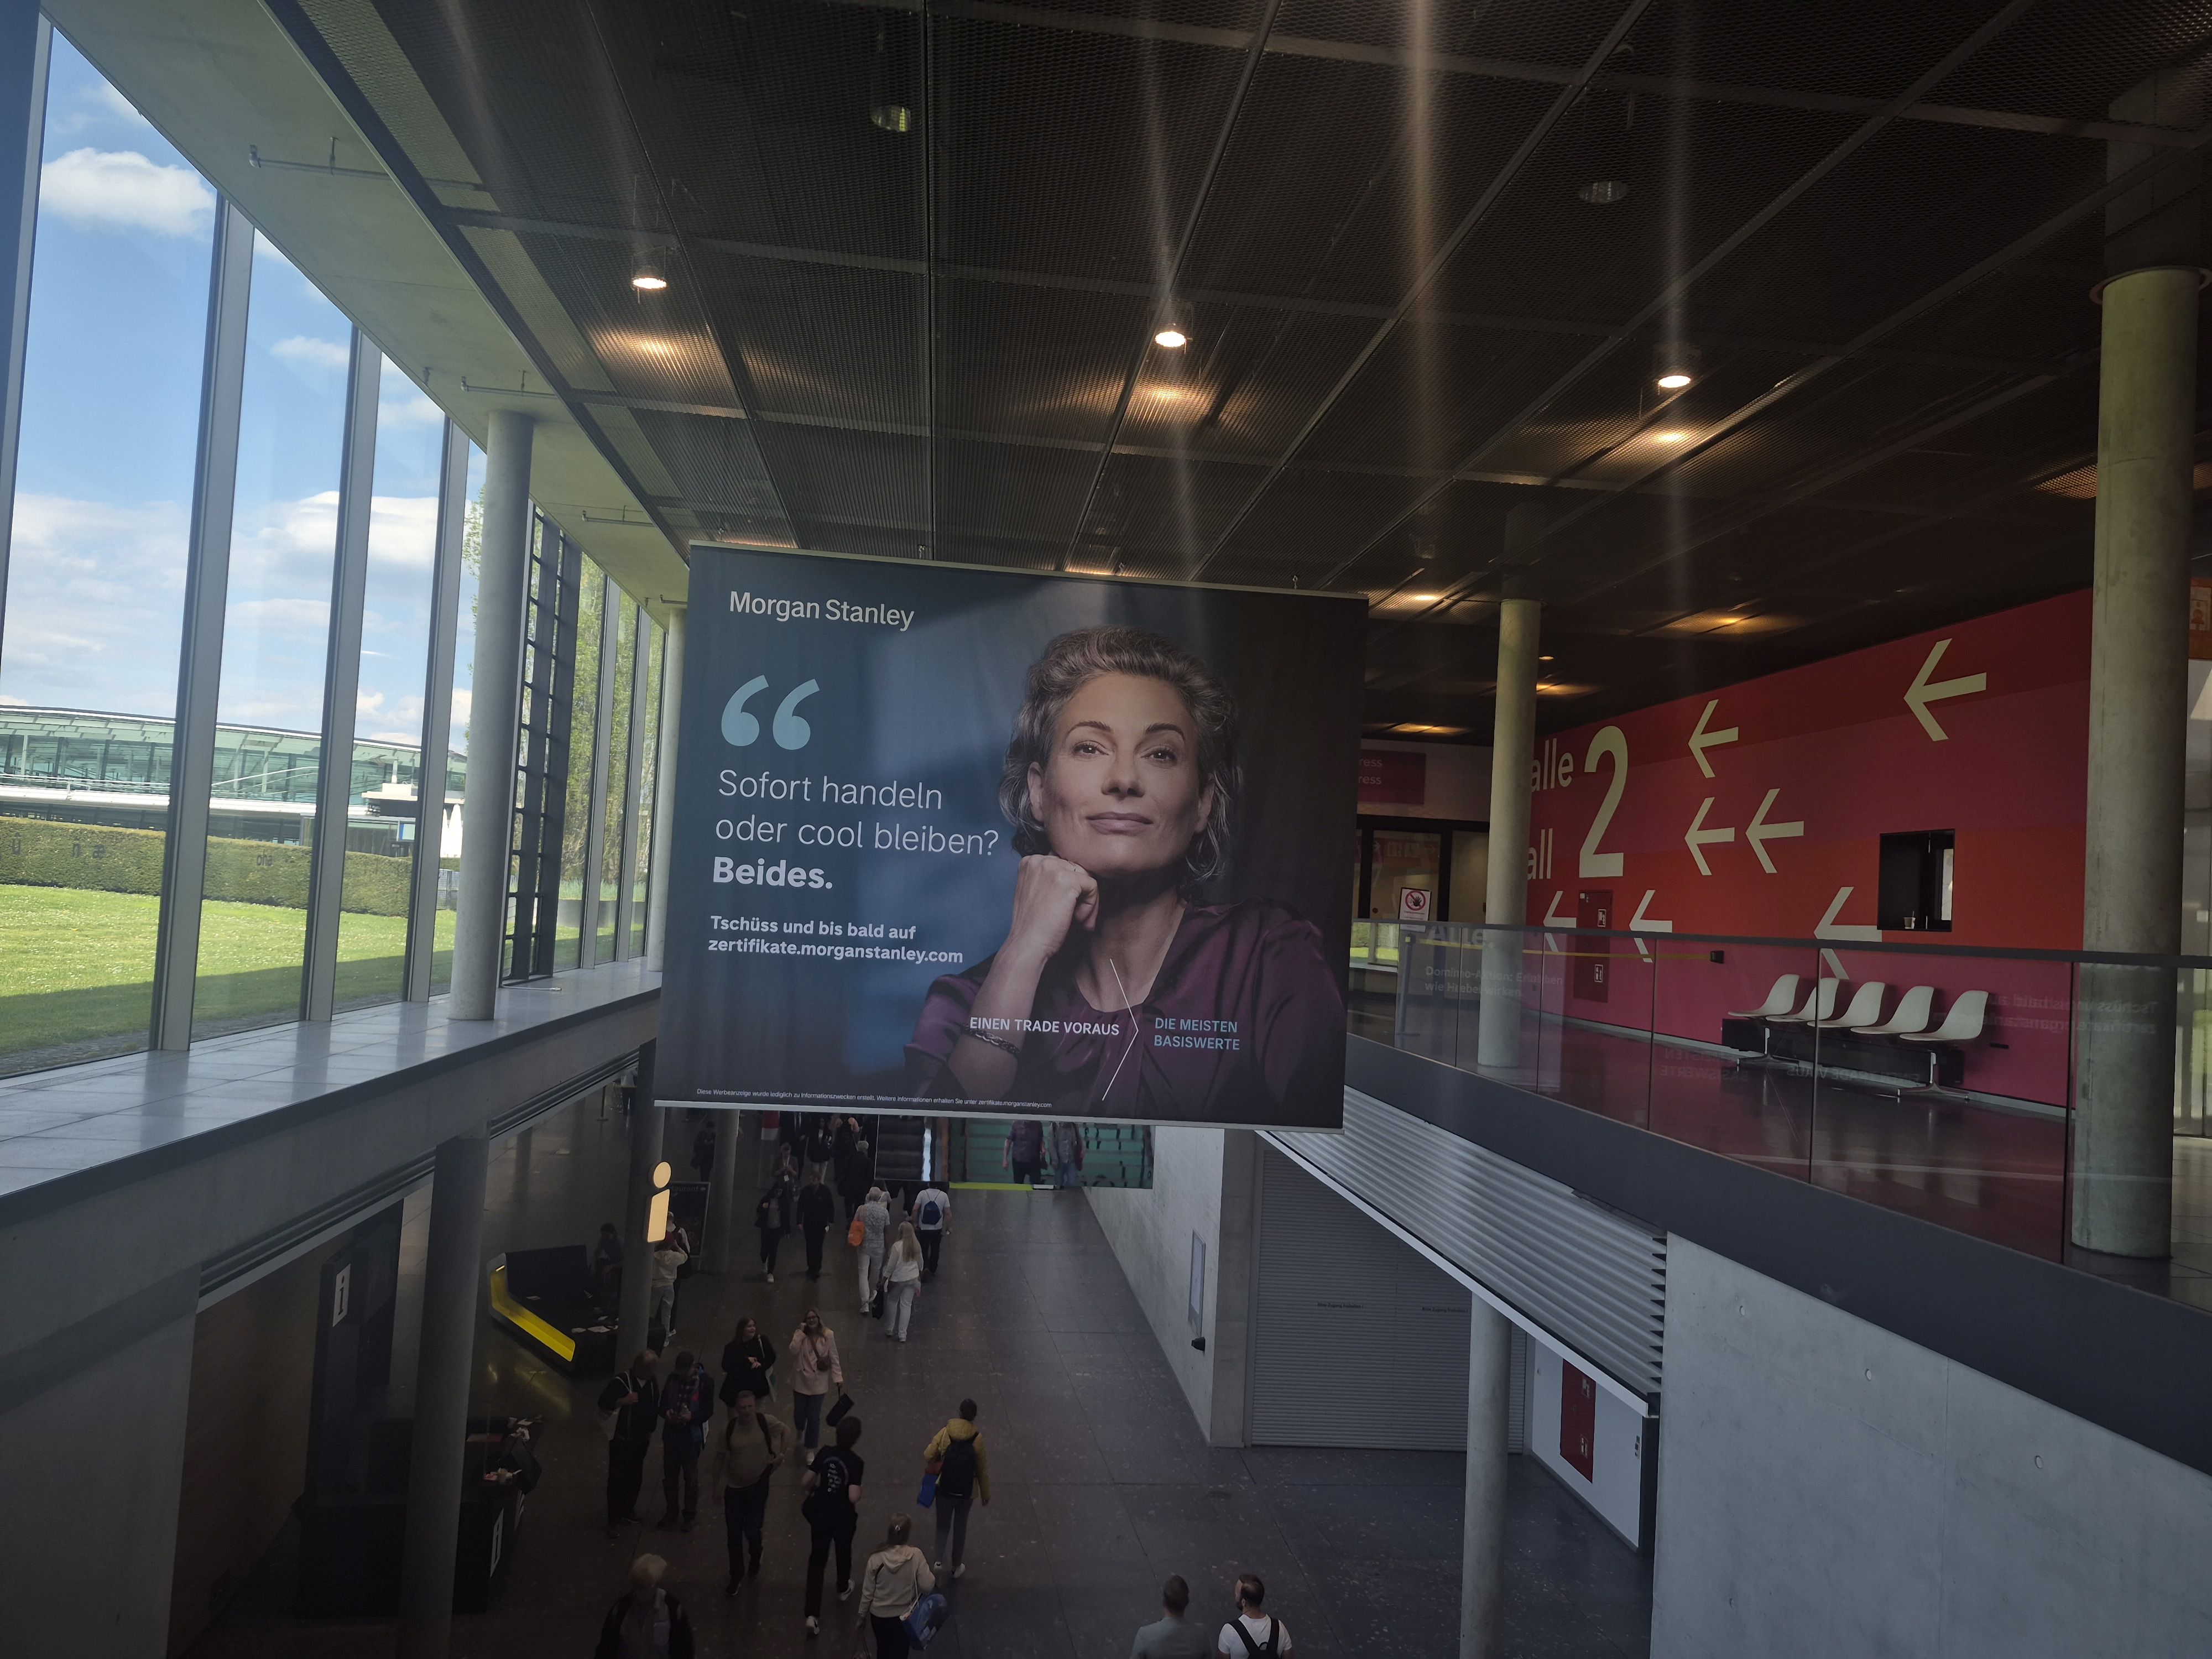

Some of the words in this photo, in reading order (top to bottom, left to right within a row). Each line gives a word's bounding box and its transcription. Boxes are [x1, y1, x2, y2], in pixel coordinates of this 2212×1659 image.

[729, 591, 820, 622] Morgan
[825, 599, 915, 632] Stanley
[1359, 758, 1383, 768] ress
[718, 769, 811, 802] Sofort
[822, 775, 942, 810] handeln
[1358, 775, 1382, 785] ress
[1530, 737, 1574, 793] alle
[1578, 725, 1629, 878] 2
[716, 814, 787, 843] oder
[798, 820, 863, 848] cool
[874, 822, 999, 855] bleiben?
[1527, 828, 1553, 880] all
[712, 856, 833, 890] Beides.
[710, 915, 779, 933] Tschüss
[782, 920, 814, 935] und
[818, 921, 843, 936] bis
[847, 922, 885, 939] bald
[888, 926, 917, 940] auf
[708, 938, 963, 965] zertifikate.morganstanley.com
[969, 1016, 1011, 1031] EINEN
[1014, 1019, 1060, 1033] TRADE
[1063, 1021, 1120, 1036] VORAUS
[1154, 1018, 1177, 1031] DIE
[1180, 1019, 1238, 1034] MEISTEN
[1154, 1035, 1240, 1051] BASISWERTE
[713, 1089, 752, 1098] Werbeanzeige
[978, 1099, 1052, 1109] zertifikate.morganstanley.com
